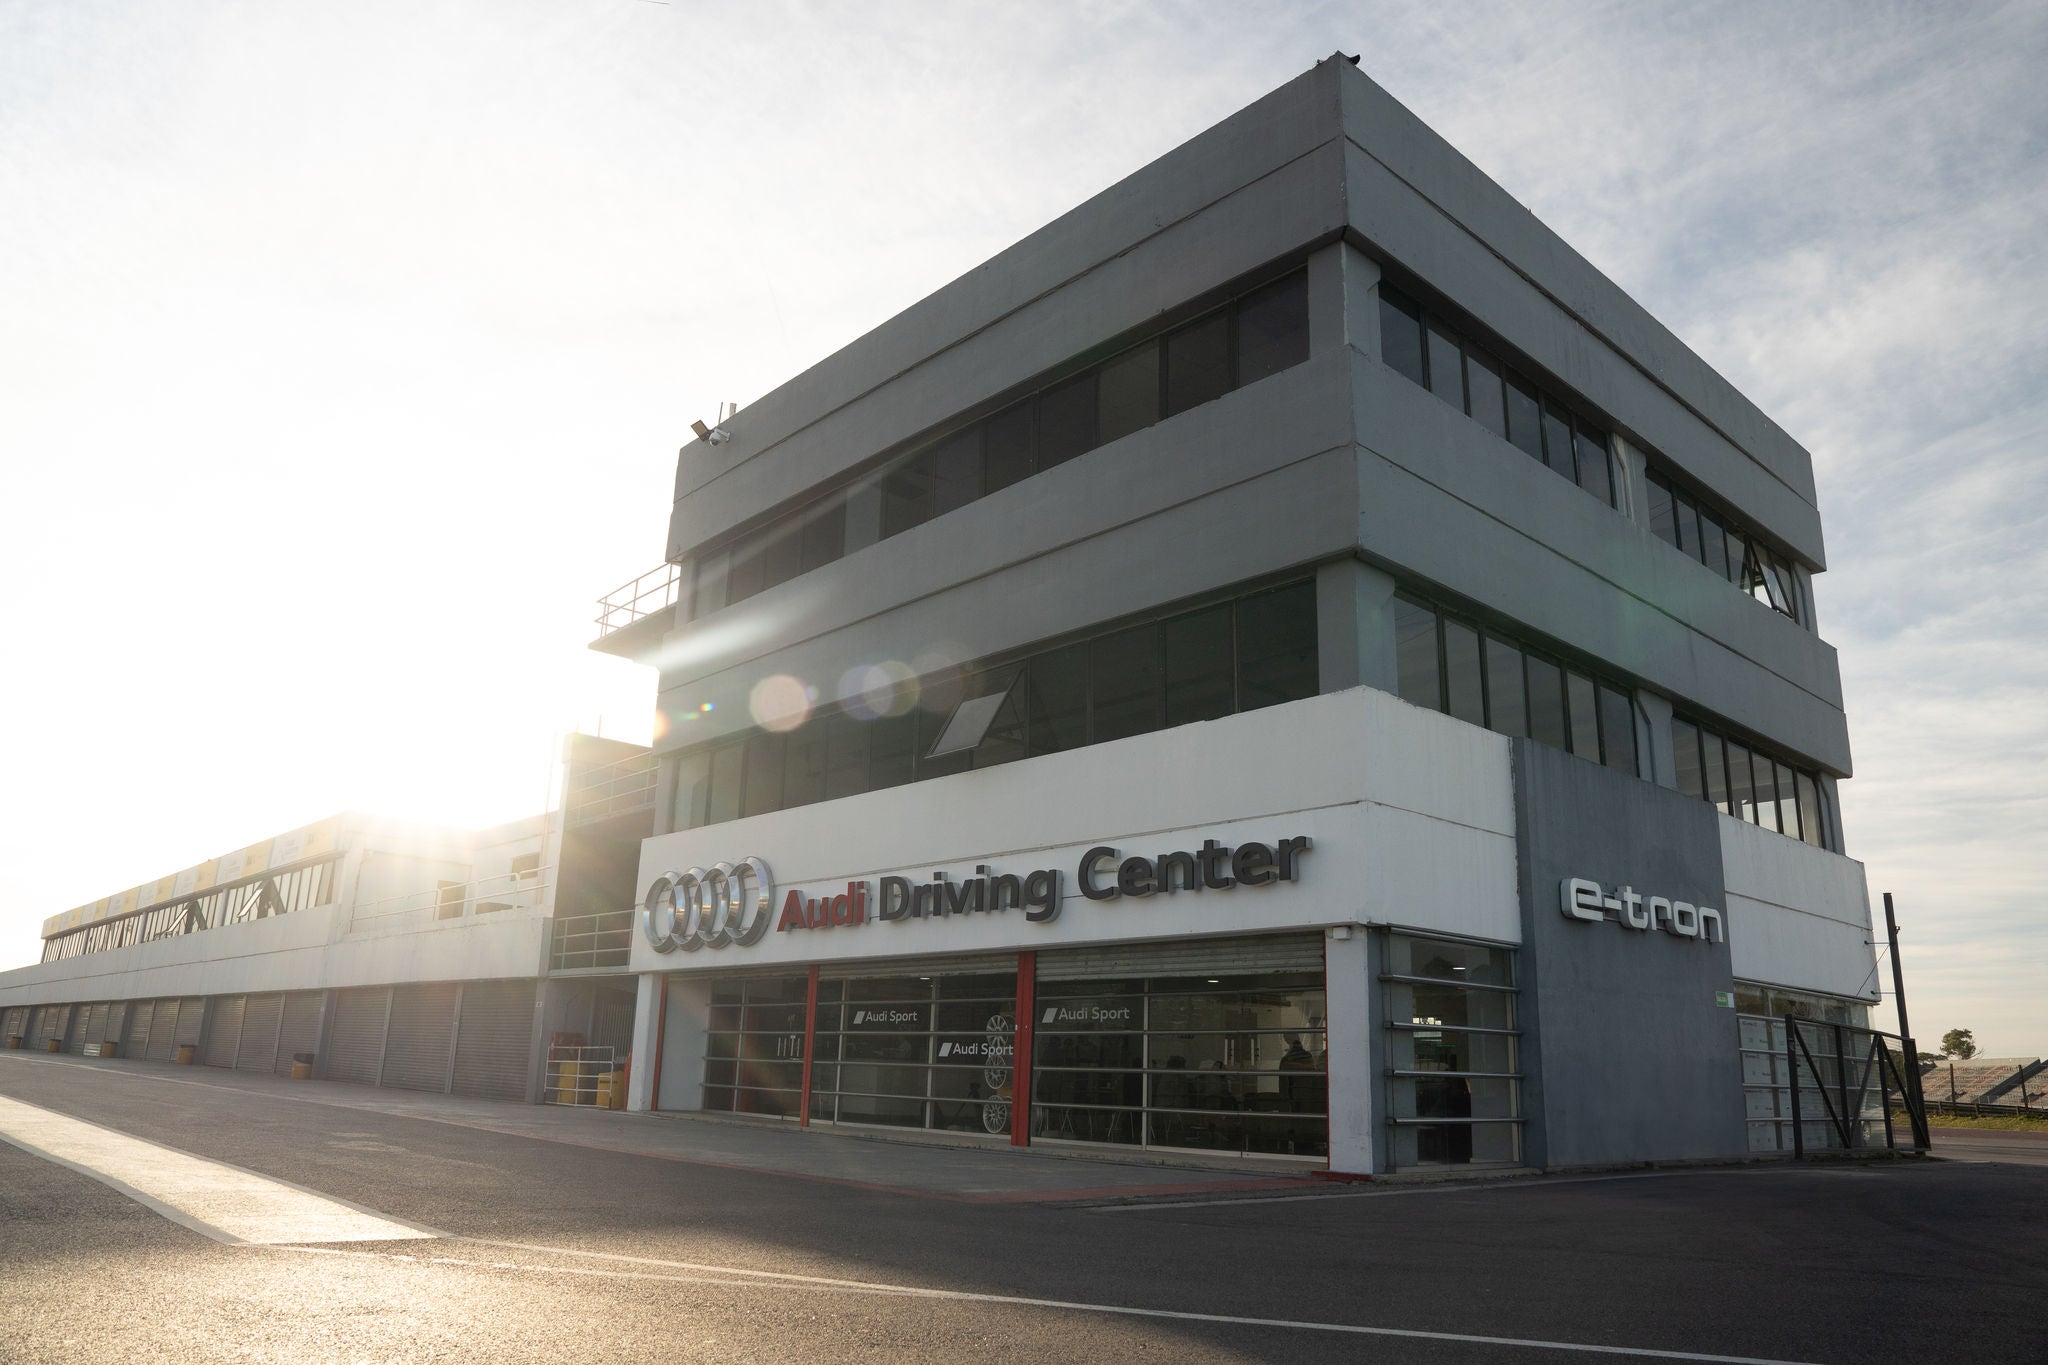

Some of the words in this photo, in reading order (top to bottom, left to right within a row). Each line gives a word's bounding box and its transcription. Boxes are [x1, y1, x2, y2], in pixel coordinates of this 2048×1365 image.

[777, 881, 870, 932] Audi
[879, 864, 1063, 923] Driving
[1077, 835, 1313, 901] Center
[1560, 877, 1724, 943] e-tron
[865, 1011, 888, 1022] Audi
[889, 1010, 918, 1024] Sport
[1058, 1007, 1088, 1020] Audi
[1091, 1006, 1130, 1022] Sport
[952, 1043, 979, 1055] Audi
[981, 1043, 1014, 1058] Sport
